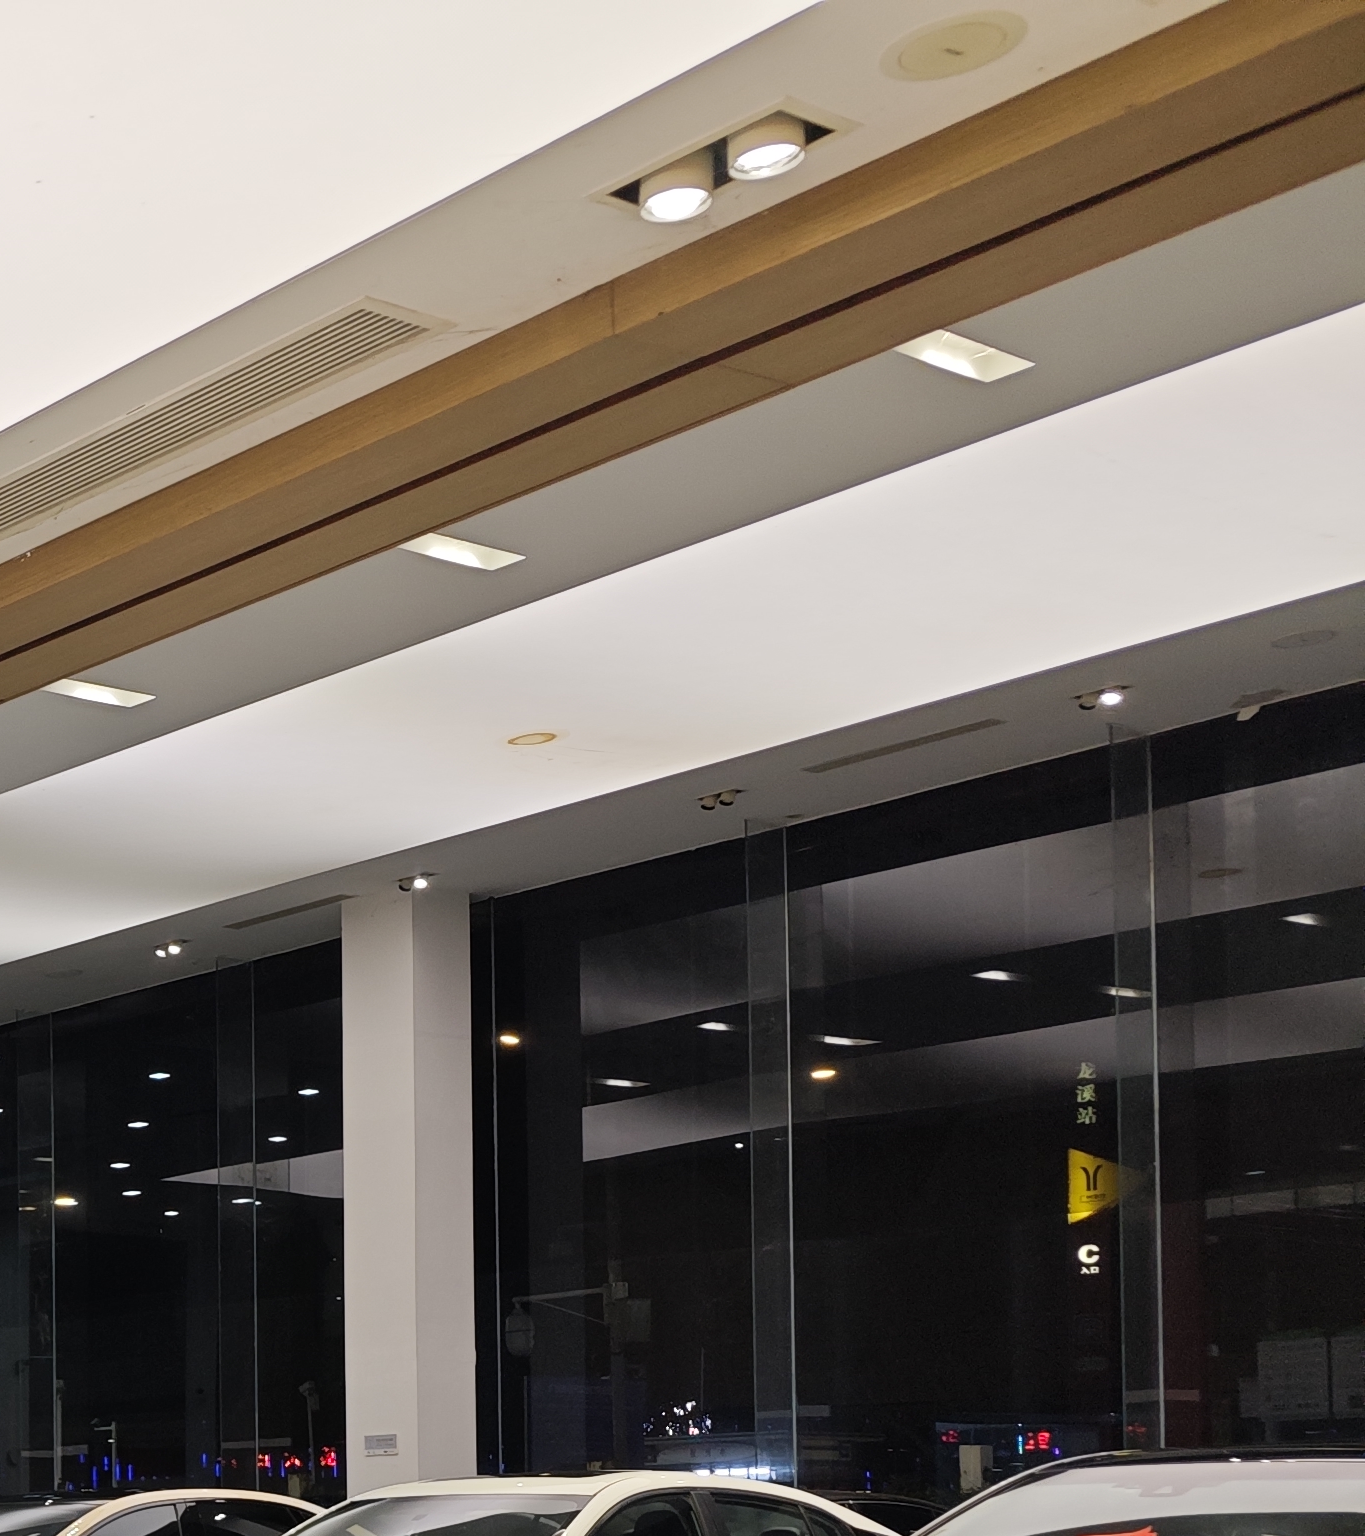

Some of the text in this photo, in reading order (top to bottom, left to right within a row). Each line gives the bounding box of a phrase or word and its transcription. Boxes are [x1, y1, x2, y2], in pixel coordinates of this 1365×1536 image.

[1076, 1062, 1097, 1125] 龙溪站
[1077, 1244, 1100, 1264] C
[1080, 1266, 1100, 1275] 入口
